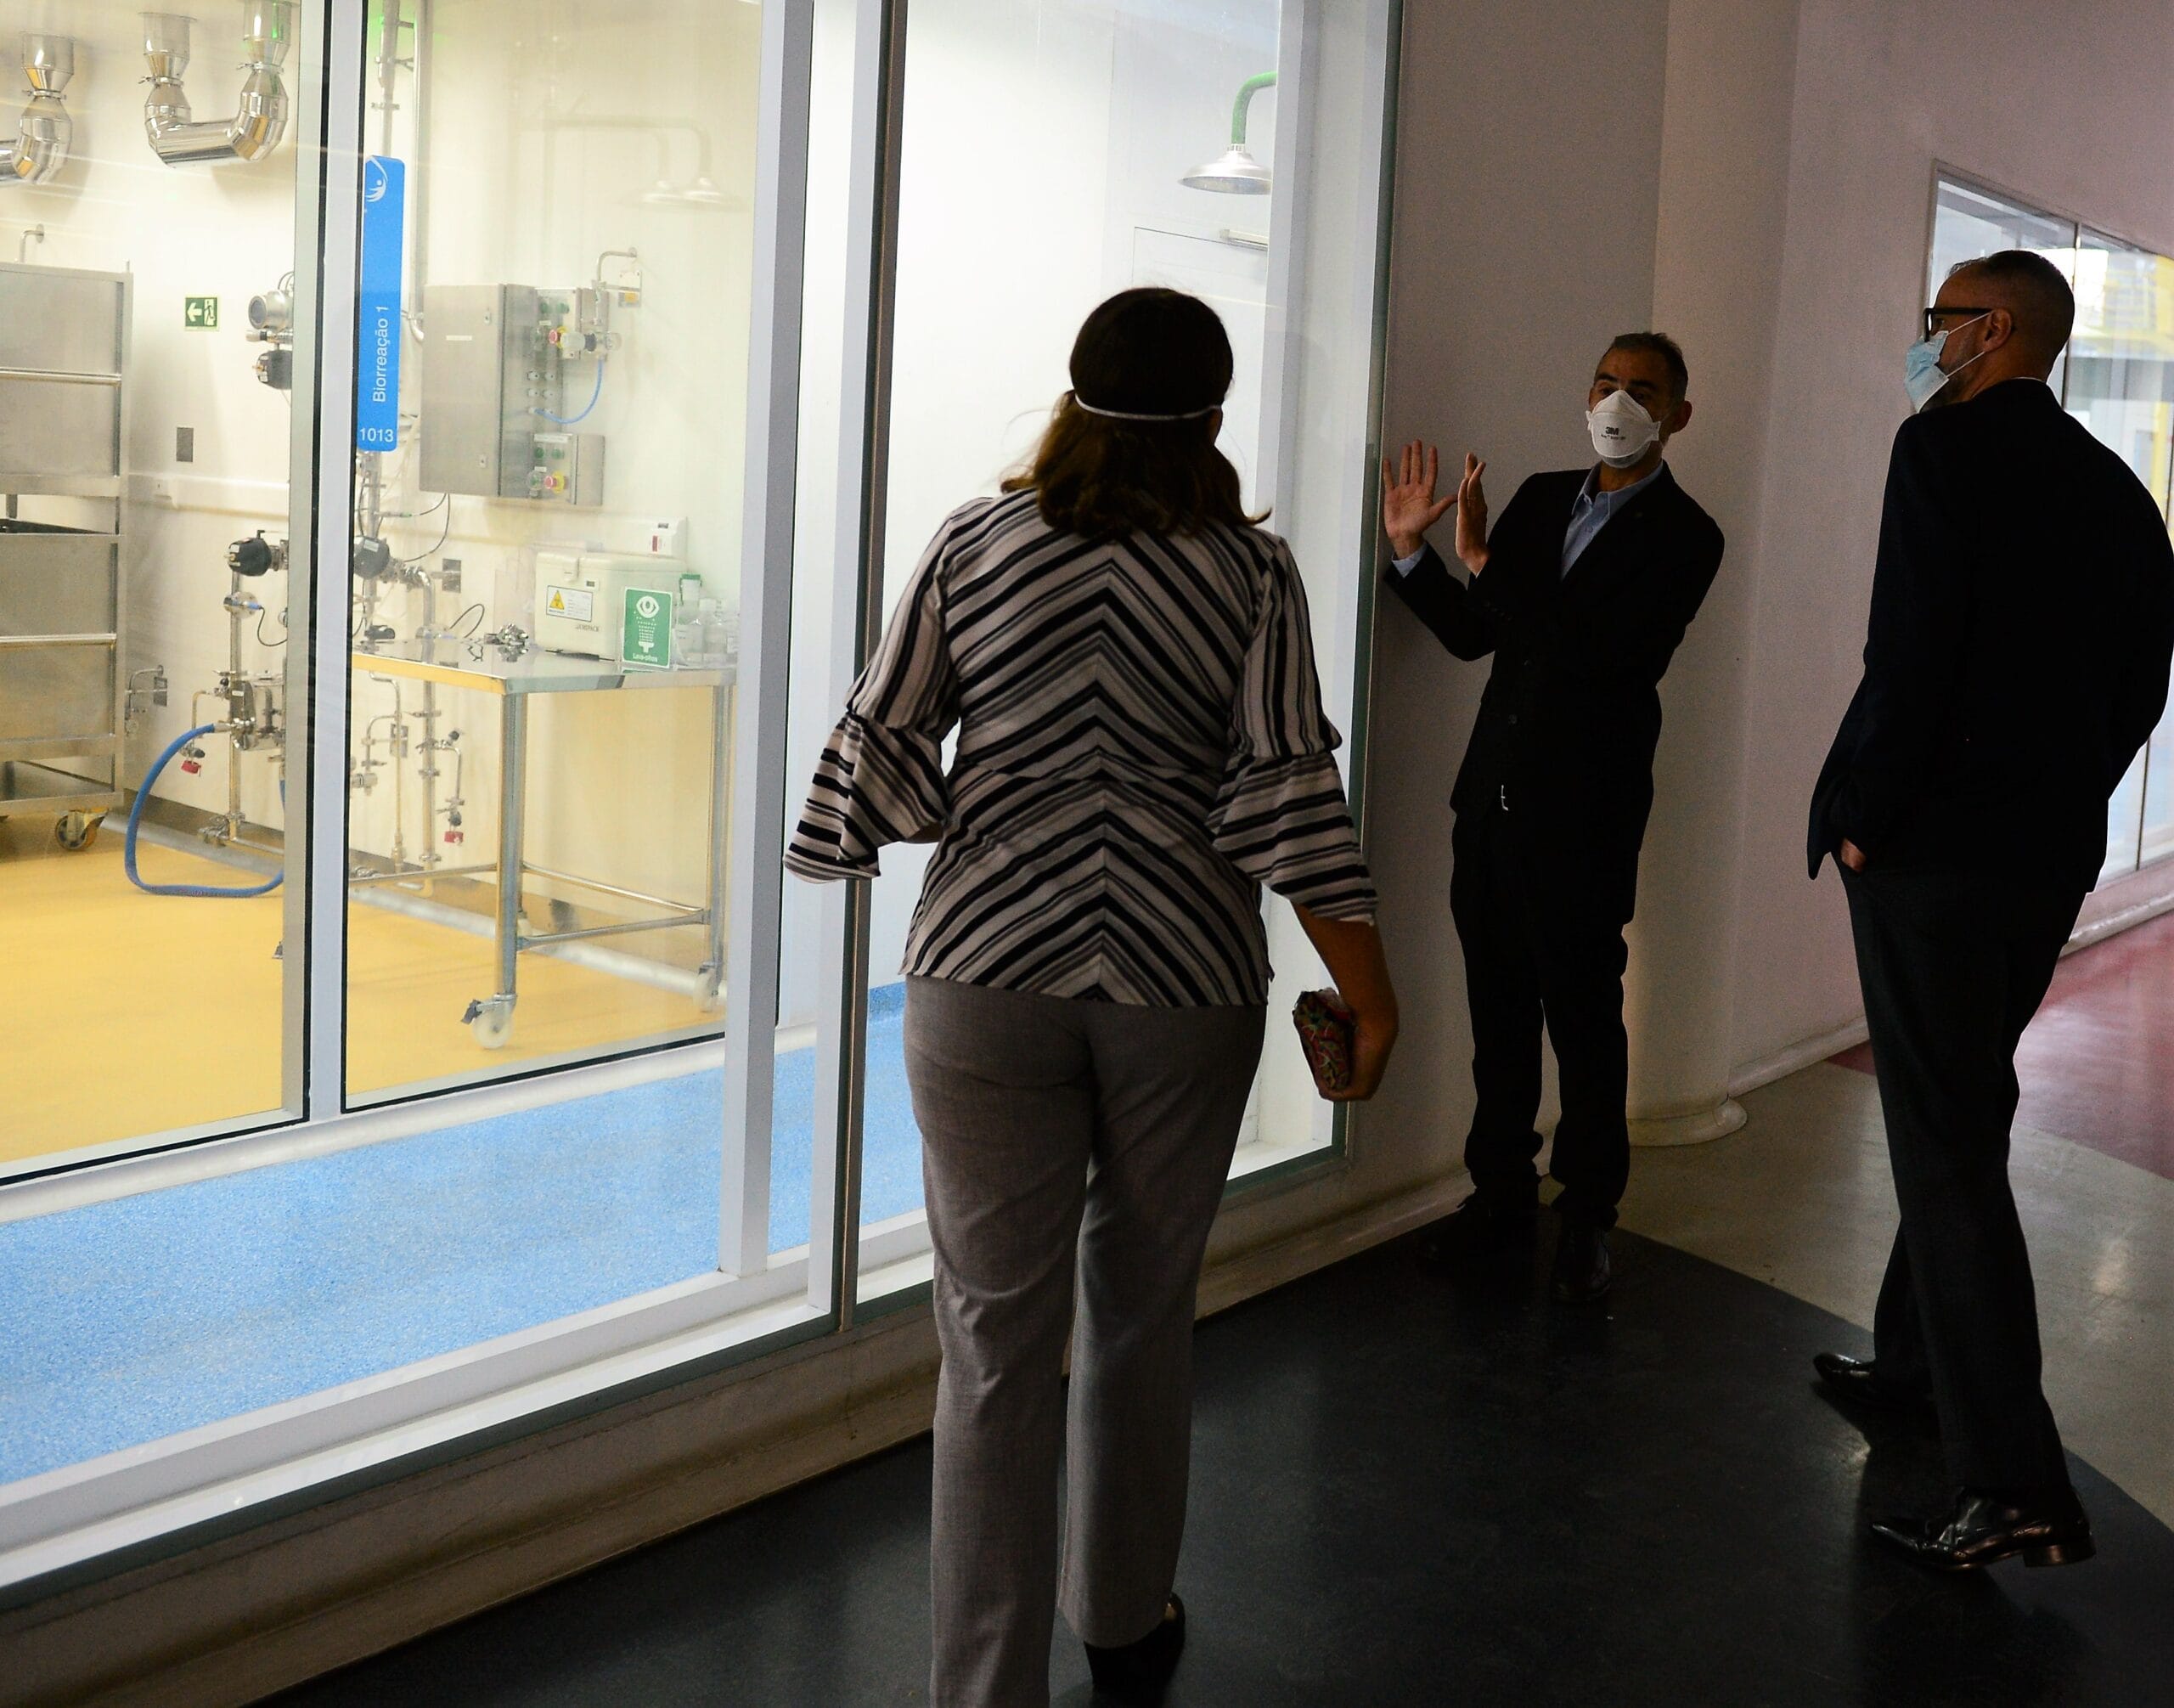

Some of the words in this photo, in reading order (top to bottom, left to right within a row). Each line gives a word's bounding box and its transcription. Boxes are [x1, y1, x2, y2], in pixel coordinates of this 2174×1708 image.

[373, 318, 391, 403] Biorreação
[359, 427, 394, 443] 1013
[1605, 426, 1619, 436] 3M
